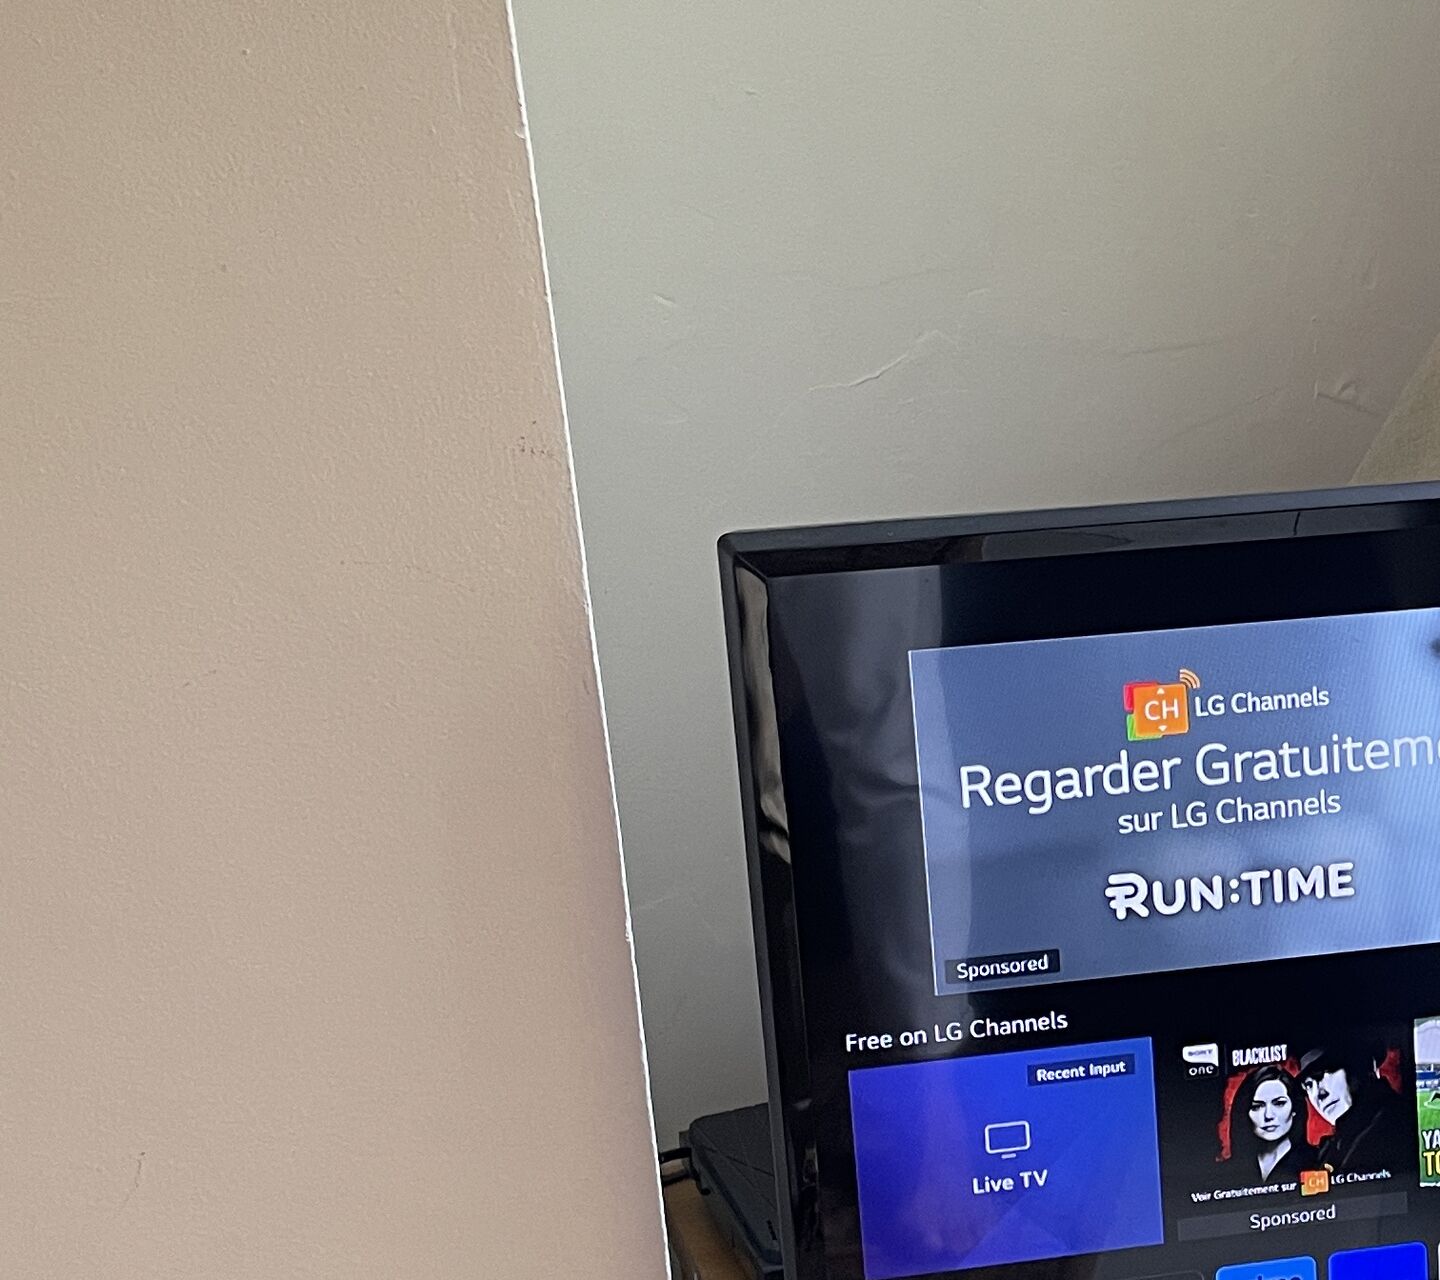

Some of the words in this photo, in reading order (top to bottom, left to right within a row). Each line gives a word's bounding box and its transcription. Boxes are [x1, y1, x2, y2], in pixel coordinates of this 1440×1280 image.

[1143, 698, 1180, 723] CH
[1194, 693, 1225, 718] LG
[1231, 685, 1330, 716] Channels
[960, 749, 1181, 815] Regarder
[1117, 808, 1163, 835] sur
[1170, 801, 1208, 831] LG
[1215, 789, 1341, 825] Channels
[1104, 861, 1356, 920] RUN:TIME
[955, 953, 1049, 982] Sponsored
[845, 1031, 893, 1053] Free
[899, 1029, 927, 1048] on
[934, 1023, 963, 1044] LG
[969, 1011, 1068, 1039] Channels
[1231, 1044, 1288, 1067] BLACKLIST
[1035, 1064, 1086, 1083] Recent
[1091, 1060, 1127, 1081] Input
[972, 1171, 1014, 1195] Live
[1020, 1169, 1048, 1190] TV
[1249, 1204, 1337, 1231] Sponsored
